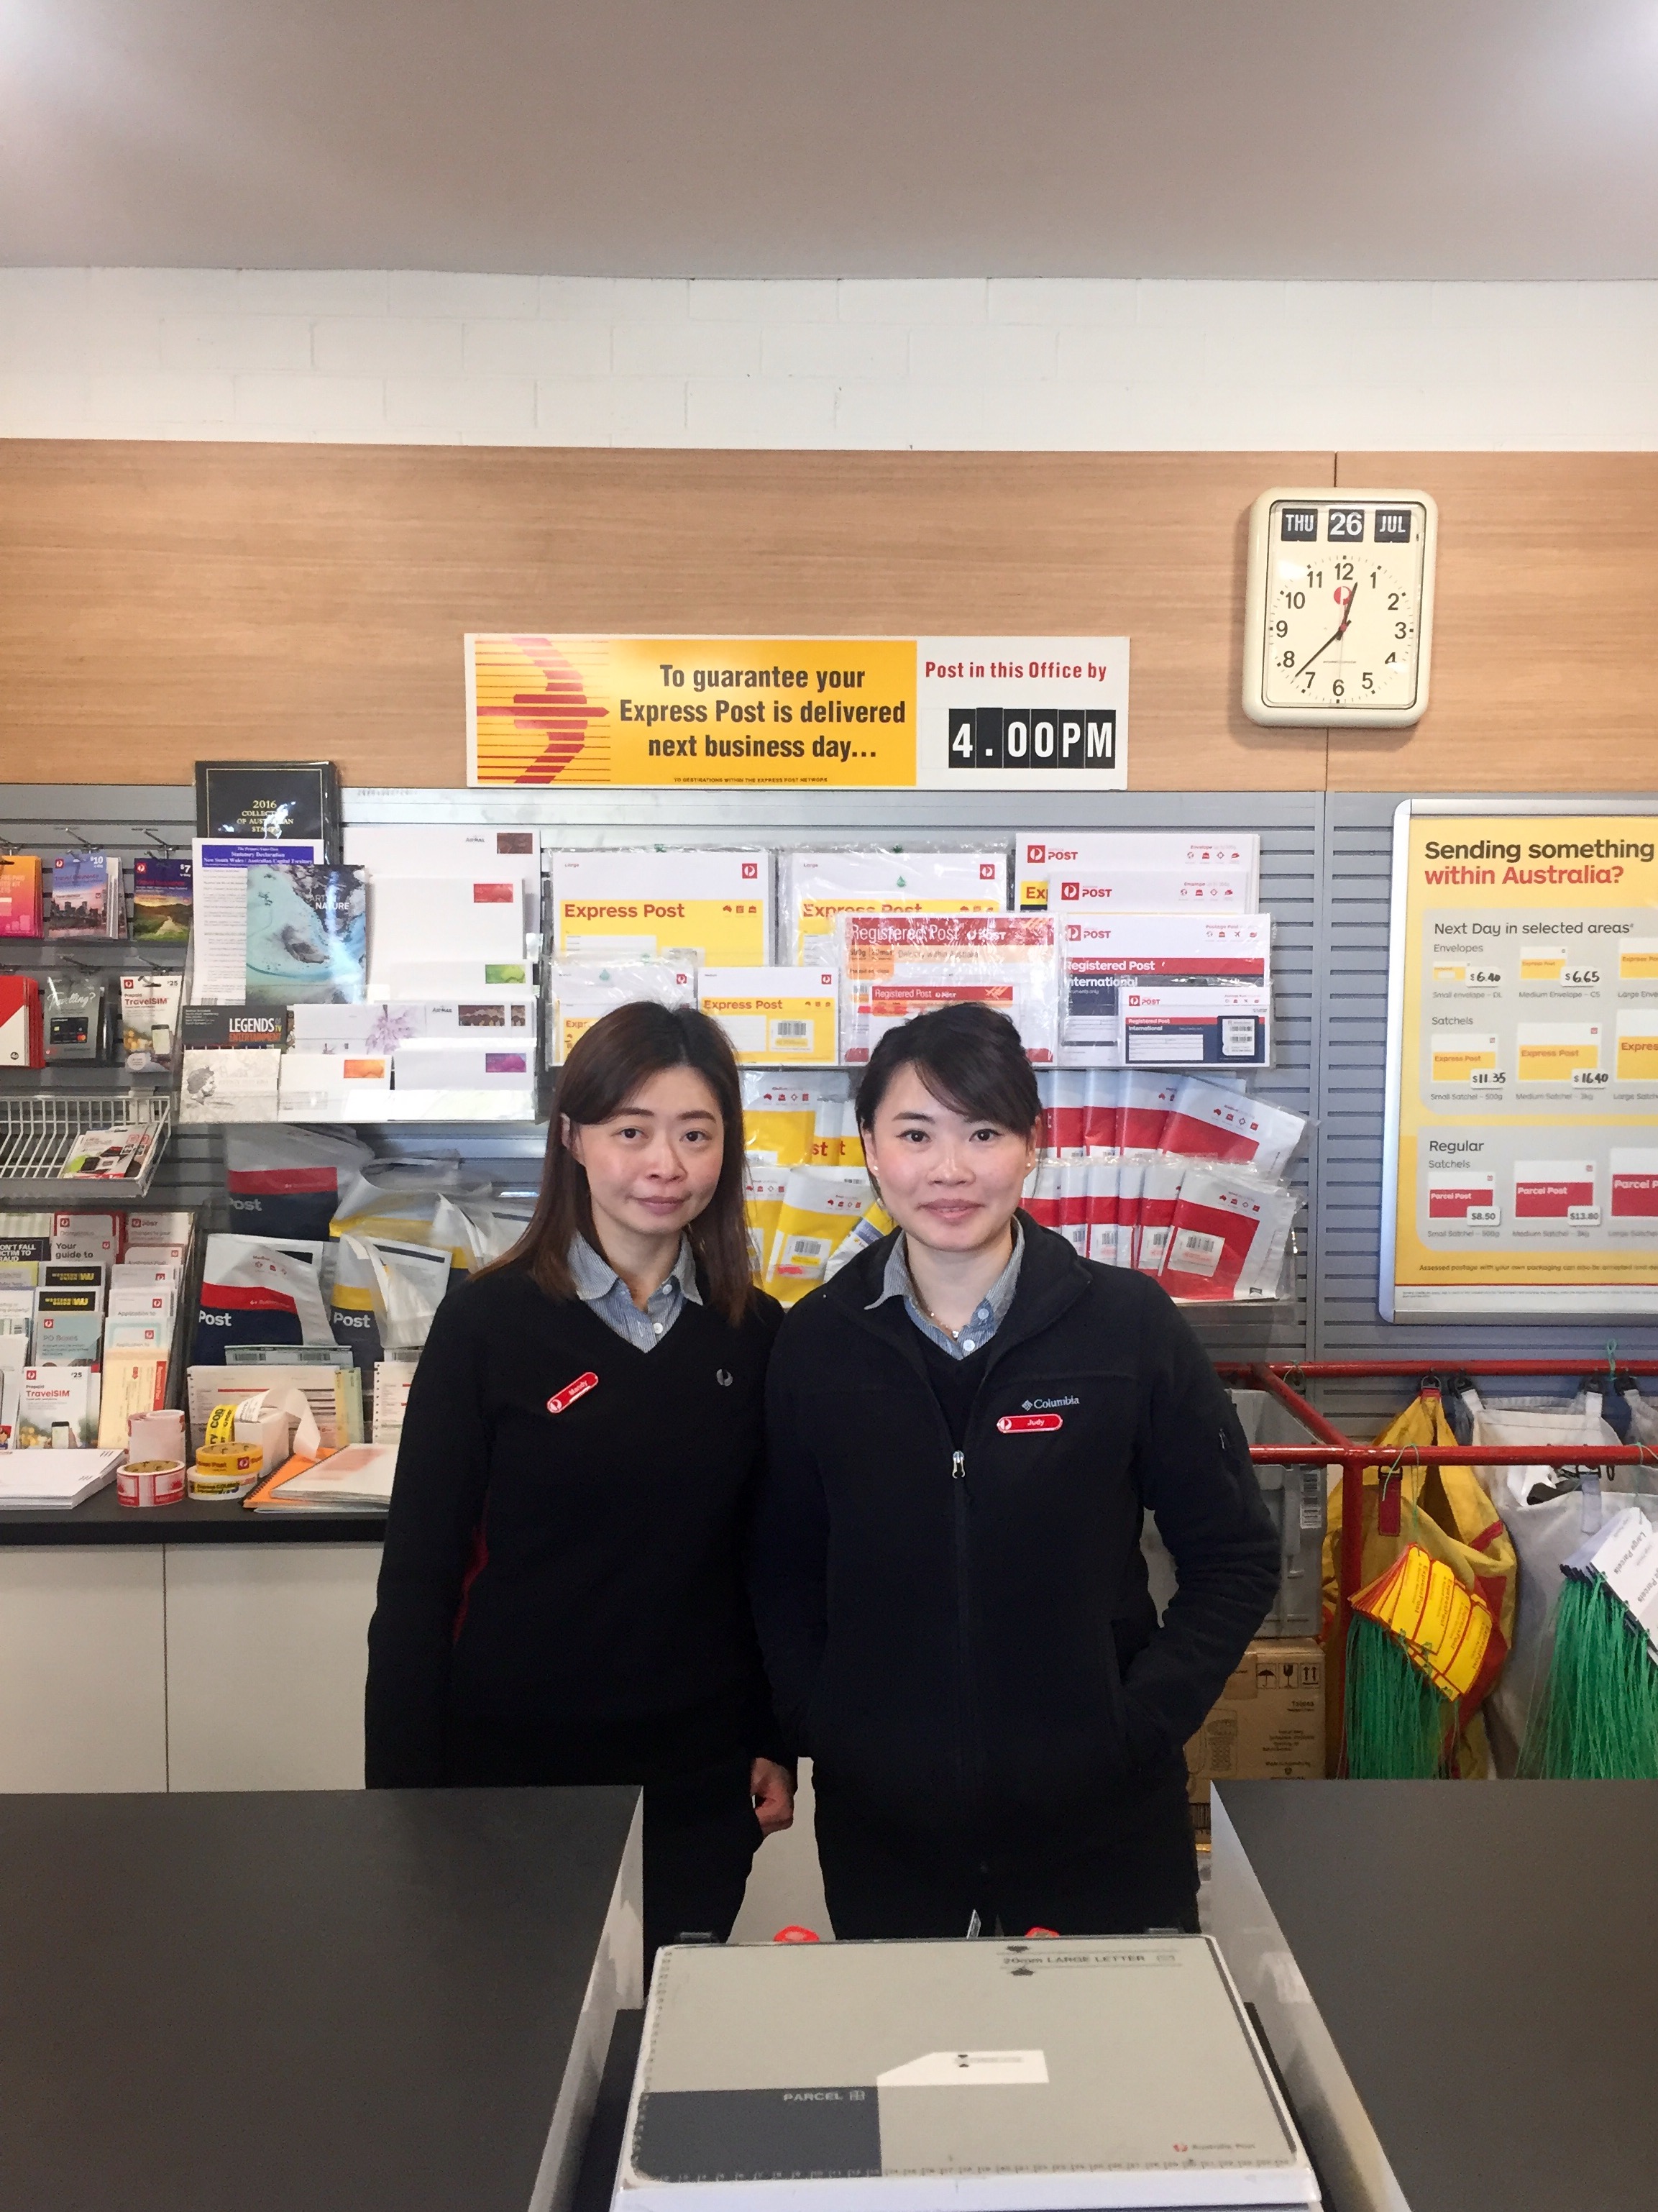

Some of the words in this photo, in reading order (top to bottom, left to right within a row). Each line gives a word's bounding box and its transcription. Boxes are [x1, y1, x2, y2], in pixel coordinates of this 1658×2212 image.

[1286, 514, 1314, 532] THU
[1330, 512, 1362, 536] 26
[1380, 516, 1406, 533] JUL
[1307, 571, 1323, 588] 11
[1334, 563, 1355, 580] 12
[1370, 571, 1377, 589] 1
[1286, 591, 1306, 610] 10
[1388, 593, 1399, 611] 2
[1275, 620, 1288, 638] 9
[1394, 622, 1407, 639] 3
[1283, 650, 1295, 668] 8
[659, 664, 684, 687] To
[693, 664, 808, 692] guarantee
[816, 669, 866, 692] your
[925, 662, 964, 678] Post
[970, 662, 984, 678] in
[990, 662, 1023, 678] this
[1029, 662, 1082, 678] Office
[1088, 662, 1107, 682] by
[1305, 672, 1316, 689] 7
[1332, 680, 1345, 696] 6
[1362, 672, 1373, 690] 5
[620, 700, 707, 727] Express
[715, 700, 766, 723] Post
[773, 700, 793, 723] is
[800, 701, 905, 723] delivered
[648, 736, 697, 757] next
[705, 735, 805, 757] business
[1048, 851, 1078, 860] POST
[1424, 840, 1521, 863] Sending
[1529, 839, 1654, 862] something
[180, 864, 191, 873] $7
[1424, 866, 1495, 885] within
[1502, 865, 1623, 885] Australia?
[1082, 889, 1112, 897] POST
[564, 903, 638, 920] Express
[643, 903, 685, 918] Post
[852, 925, 925, 943] Registered
[929, 924, 959, 941] Post
[1434, 923, 1467, 934] Next
[1472, 923, 1501, 936] Day
[1506, 922, 1518, 934] in
[1522, 922, 1583, 934] selected
[1434, 943, 1483, 954] Envelopes
[1064, 960, 1127, 973] Registered
[1129, 961, 1155, 971] Post
[875, 989, 913, 999] Registered
[916, 990, 932, 998] Post
[704, 1000, 752, 1012] Express
[756, 1000, 782, 1010] Post
[229, 1018, 275, 1033] LEGENDS
[1432, 1016, 1473, 1025] Satchels
[1429, 1141, 1485, 1154] Regular
[1429, 1159, 1471, 1169] Satchels
[1614, 1180, 1649, 1189] Parcel
[198, 1310, 232, 1327] Post
[333, 1312, 371, 1329] Post
[1033, 1395, 1080, 1409] Columbia
[1027, 1418, 1045, 1427] Judy
[1631, 1531, 1647, 1550] Large
[1613, 1550, 1634, 1576] Parcels
[1637, 1578, 1658, 1604] Parcels
[1047, 1955, 1091, 1964] LARGE
[1094, 1955, 1145, 1963] LETTER
[782, 2092, 843, 2102] PARCEL
